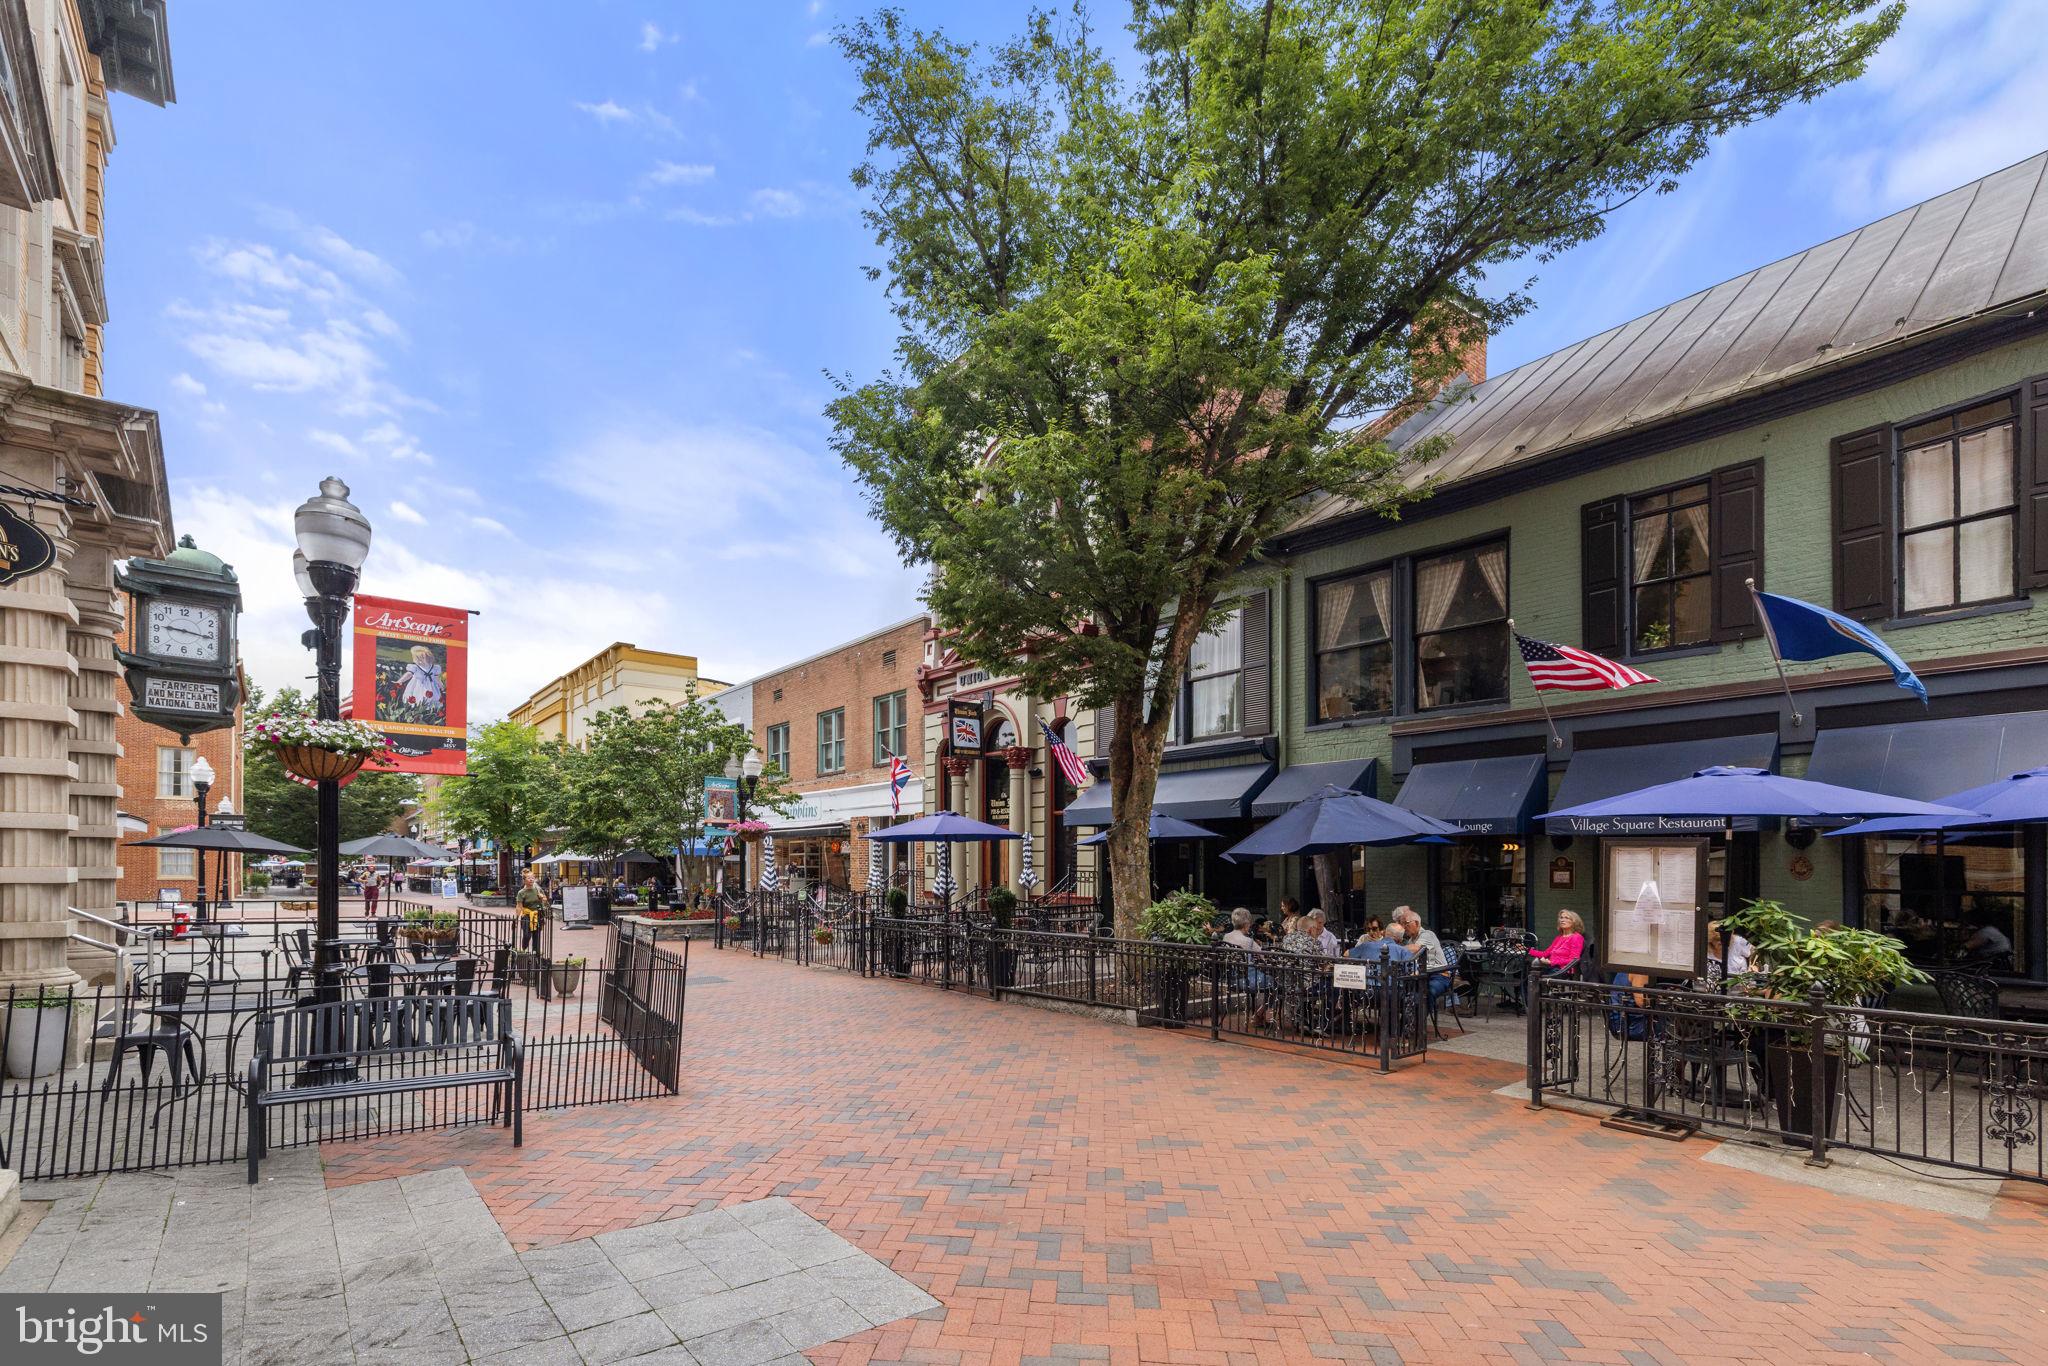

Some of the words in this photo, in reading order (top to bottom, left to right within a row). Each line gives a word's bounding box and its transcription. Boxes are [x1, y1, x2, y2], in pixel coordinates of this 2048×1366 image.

[164, 607, 172, 615] 11
[154, 624, 160, 632] 9
[365, 612, 443, 635] ArtScape
[162, 680, 204, 692] FARMERS
[148, 688, 164, 697] AND
[168, 690, 218, 702] MERCHANTS
[148, 697, 192, 708] NATIONAL
[194, 702, 218, 710] BANK
[1570, 818, 1610, 832] Village
[1612, 817, 1654, 832] Square
[1658, 816, 1726, 829] Restaurant
